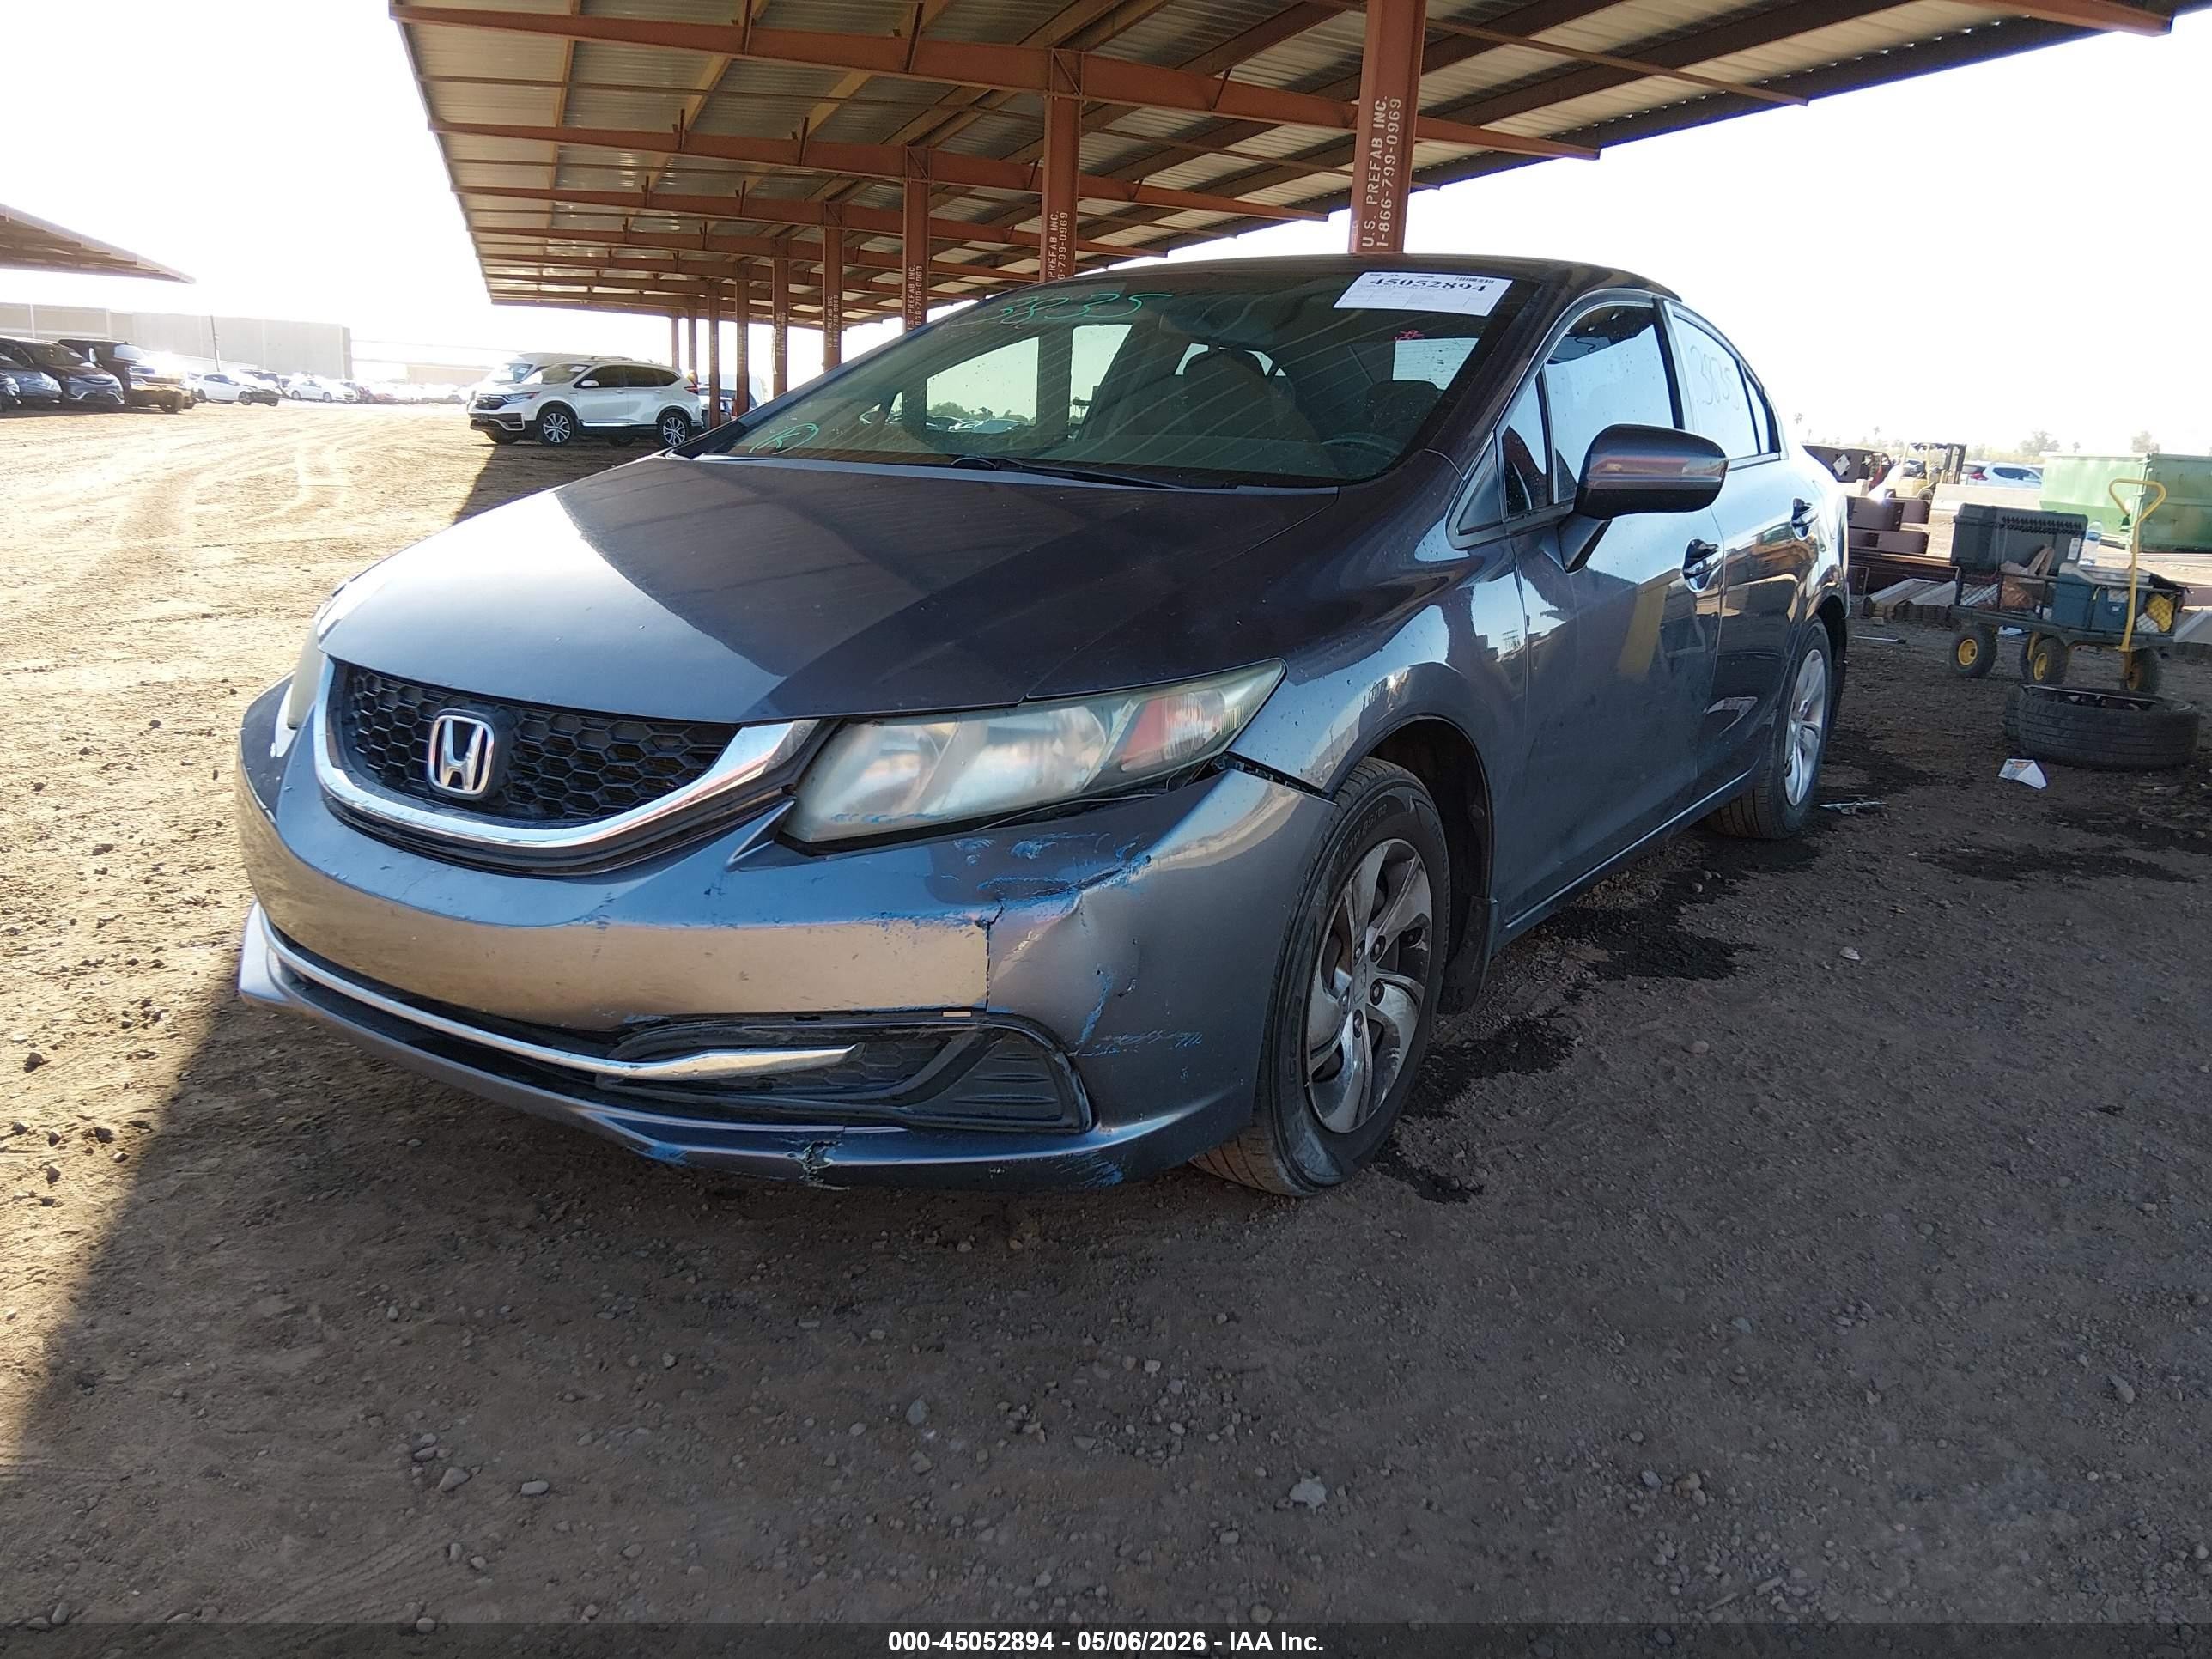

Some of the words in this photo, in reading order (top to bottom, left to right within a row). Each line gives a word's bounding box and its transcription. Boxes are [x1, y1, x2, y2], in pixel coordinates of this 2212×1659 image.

[1373, 95, 1389, 129] INC.
[1366, 137, 1384, 205] PREFAB
[1376, 98, 1401, 247] 1-866-799-0969
[1050, 210, 1059, 231] INC.
[1362, 216, 1376, 247] U.S.
[1048, 236, 1058, 278] PREFAB
[1370, 276, 1487, 293] 45052894
